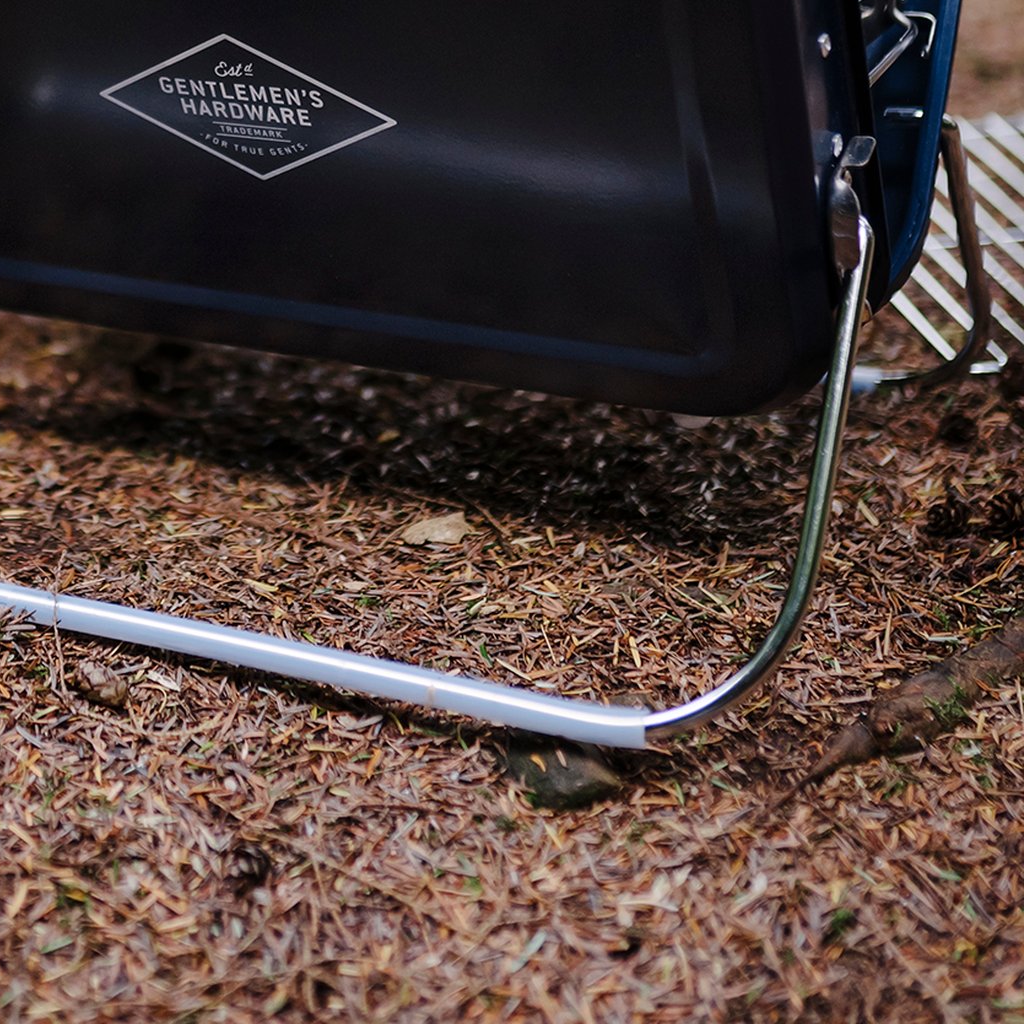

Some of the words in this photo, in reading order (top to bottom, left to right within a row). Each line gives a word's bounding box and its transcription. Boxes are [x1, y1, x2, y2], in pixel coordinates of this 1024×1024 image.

[158, 76, 324, 108] GENTLEMEN'S
[180, 98, 312, 127] HARDWARE
[219, 125, 284, 139] TRADEMARK
[234, 144, 264, 156] TRUE
